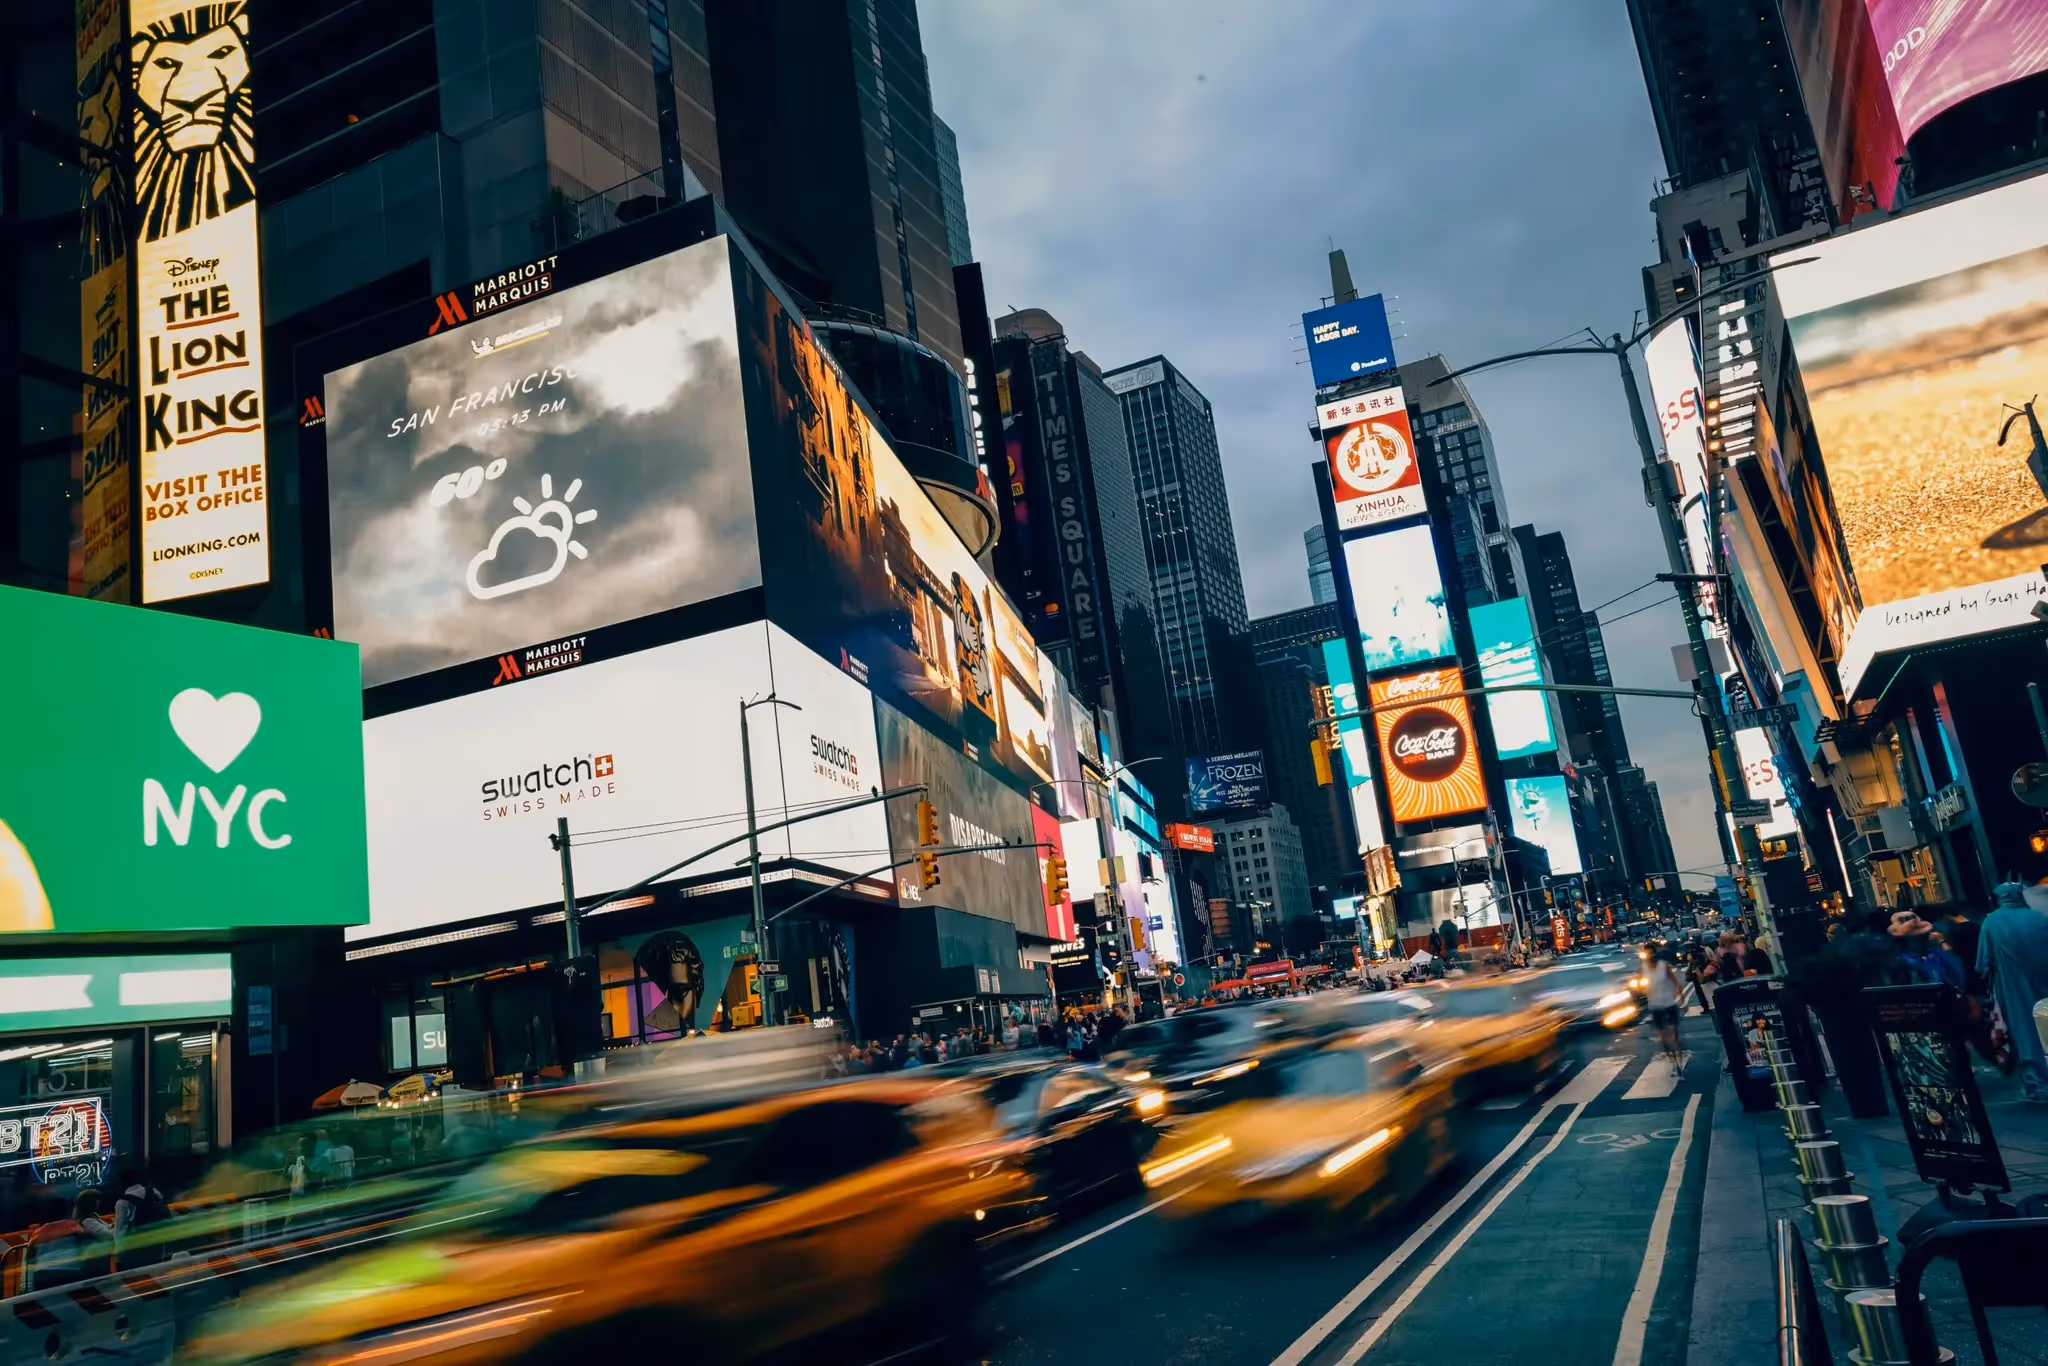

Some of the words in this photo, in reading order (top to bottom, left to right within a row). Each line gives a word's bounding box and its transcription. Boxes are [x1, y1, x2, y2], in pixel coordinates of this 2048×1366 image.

[164, 257, 219, 277] Disney
[474, 255, 558, 296] MARRIOTT
[172, 274, 217, 288] PRESENTS
[159, 284, 230, 324] THE
[475, 276, 549, 313] MARQUIS
[1313, 321, 1340, 335] HAPPY
[1314, 330, 1341, 344] LABOR
[537, 397, 567, 418] PM
[1325, 395, 1396, 421] 新华通讯社
[387, 405, 440, 438] SAN
[145, 474, 208, 502] VISIT
[218, 464, 262, 488] THE
[146, 500, 188, 521] BOX
[197, 486, 263, 511] OFFICE
[1038, 371, 1071, 483] TIMES
[1060, 496, 1096, 640] SQUARE
[1355, 495, 1406, 514] XINHUA
[1346, 510, 1376, 525] NEWS
[153, 532, 261, 562] LIONKING.COM
[1960, 596, 1978, 611] by
[525, 637, 587, 661] MARRIOTT
[526, 651, 581, 673] MARQUIS
[1745, 713, 1759, 727] W
[1766, 708, 1782, 722] 45
[810, 734, 852, 773] swatch
[1395, 727, 1457, 757] Coca-Cola
[1426, 749, 1455, 761] SUGAR
[481, 756, 593, 804] swatch
[813, 762, 838, 782] SWISS
[1207, 761, 1263, 782] FROZEN
[483, 797, 545, 821] SWISS
[559, 781, 617, 805] MADE
[142, 778, 293, 850] NYC
